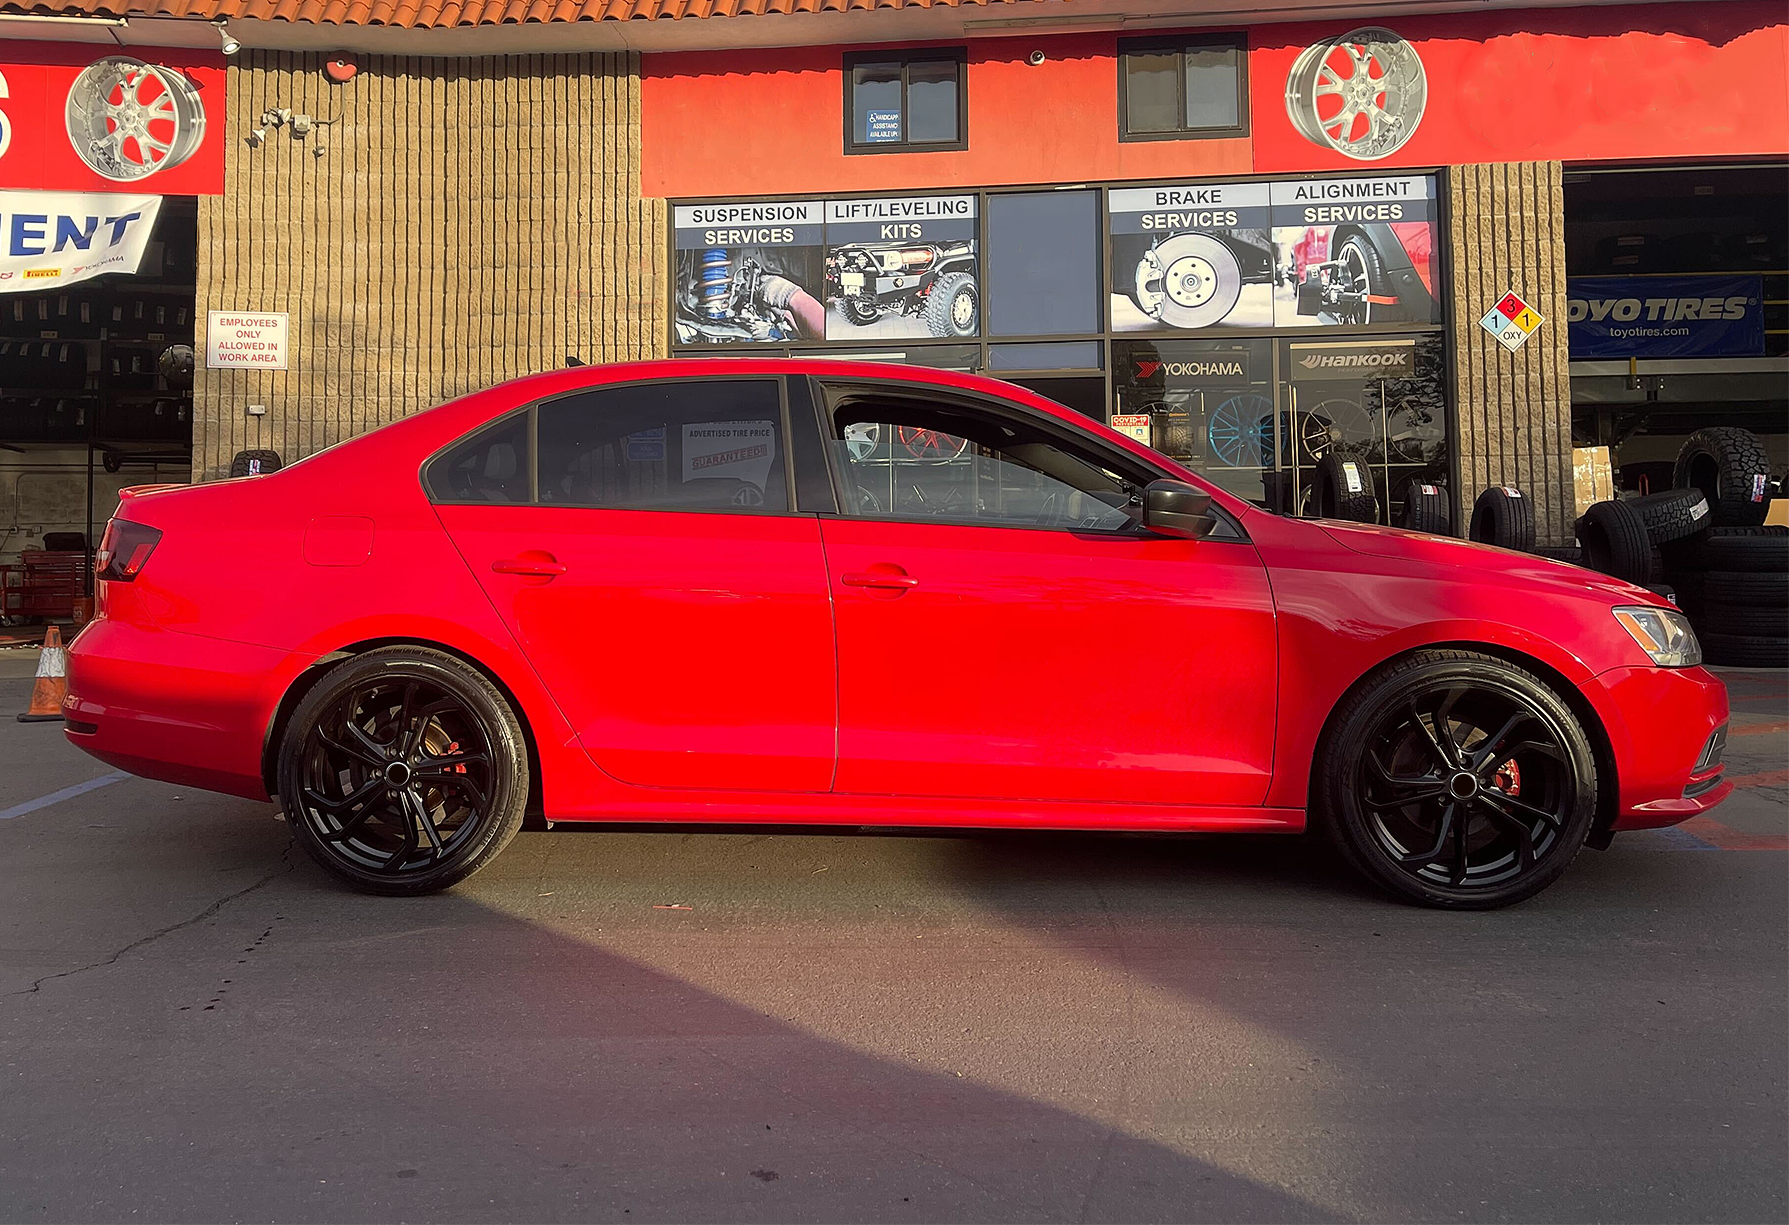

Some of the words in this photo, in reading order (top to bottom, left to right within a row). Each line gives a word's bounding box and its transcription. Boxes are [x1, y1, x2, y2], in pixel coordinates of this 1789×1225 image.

[1155, 189, 1222, 206] BRAKE
[1295, 181, 1411, 200] ALIGNMENT
[692, 206, 808, 223] SUSPENSION
[835, 200, 968, 218] LIFT/LEVELING
[1304, 204, 1403, 223] SERVICES
[1141, 211, 1238, 229] SERVICES
[0, 211, 141, 256] ENT
[704, 227, 794, 245] SERVICES
[880, 223, 922, 239] KITS
[26, 269, 59, 278] PIRELLI
[1506, 298, 1516, 313] 3
[1567, 299, 1642, 322] OYO
[1645, 296, 1748, 321] TIRES
[220, 318, 278, 328] EMPLOYEES
[1491, 314, 1498, 329] 1
[1522, 312, 1529, 327] 1
[236, 330, 261, 338] ONLY
[1503, 331, 1522, 340] OXY
[1609, 327, 1689, 338] toyotires.com
[218, 341, 265, 351] ALLOWED
[268, 342, 278, 351] IN
[218, 353, 248, 361] WORK
[251, 353, 277, 362] AREA
[1163, 361, 1243, 376] YOKOHAMA
[689, 429, 731, 438] ADVERTISED
[733, 429, 748, 437] TIRE
[750, 429, 770, 437] PRICE
